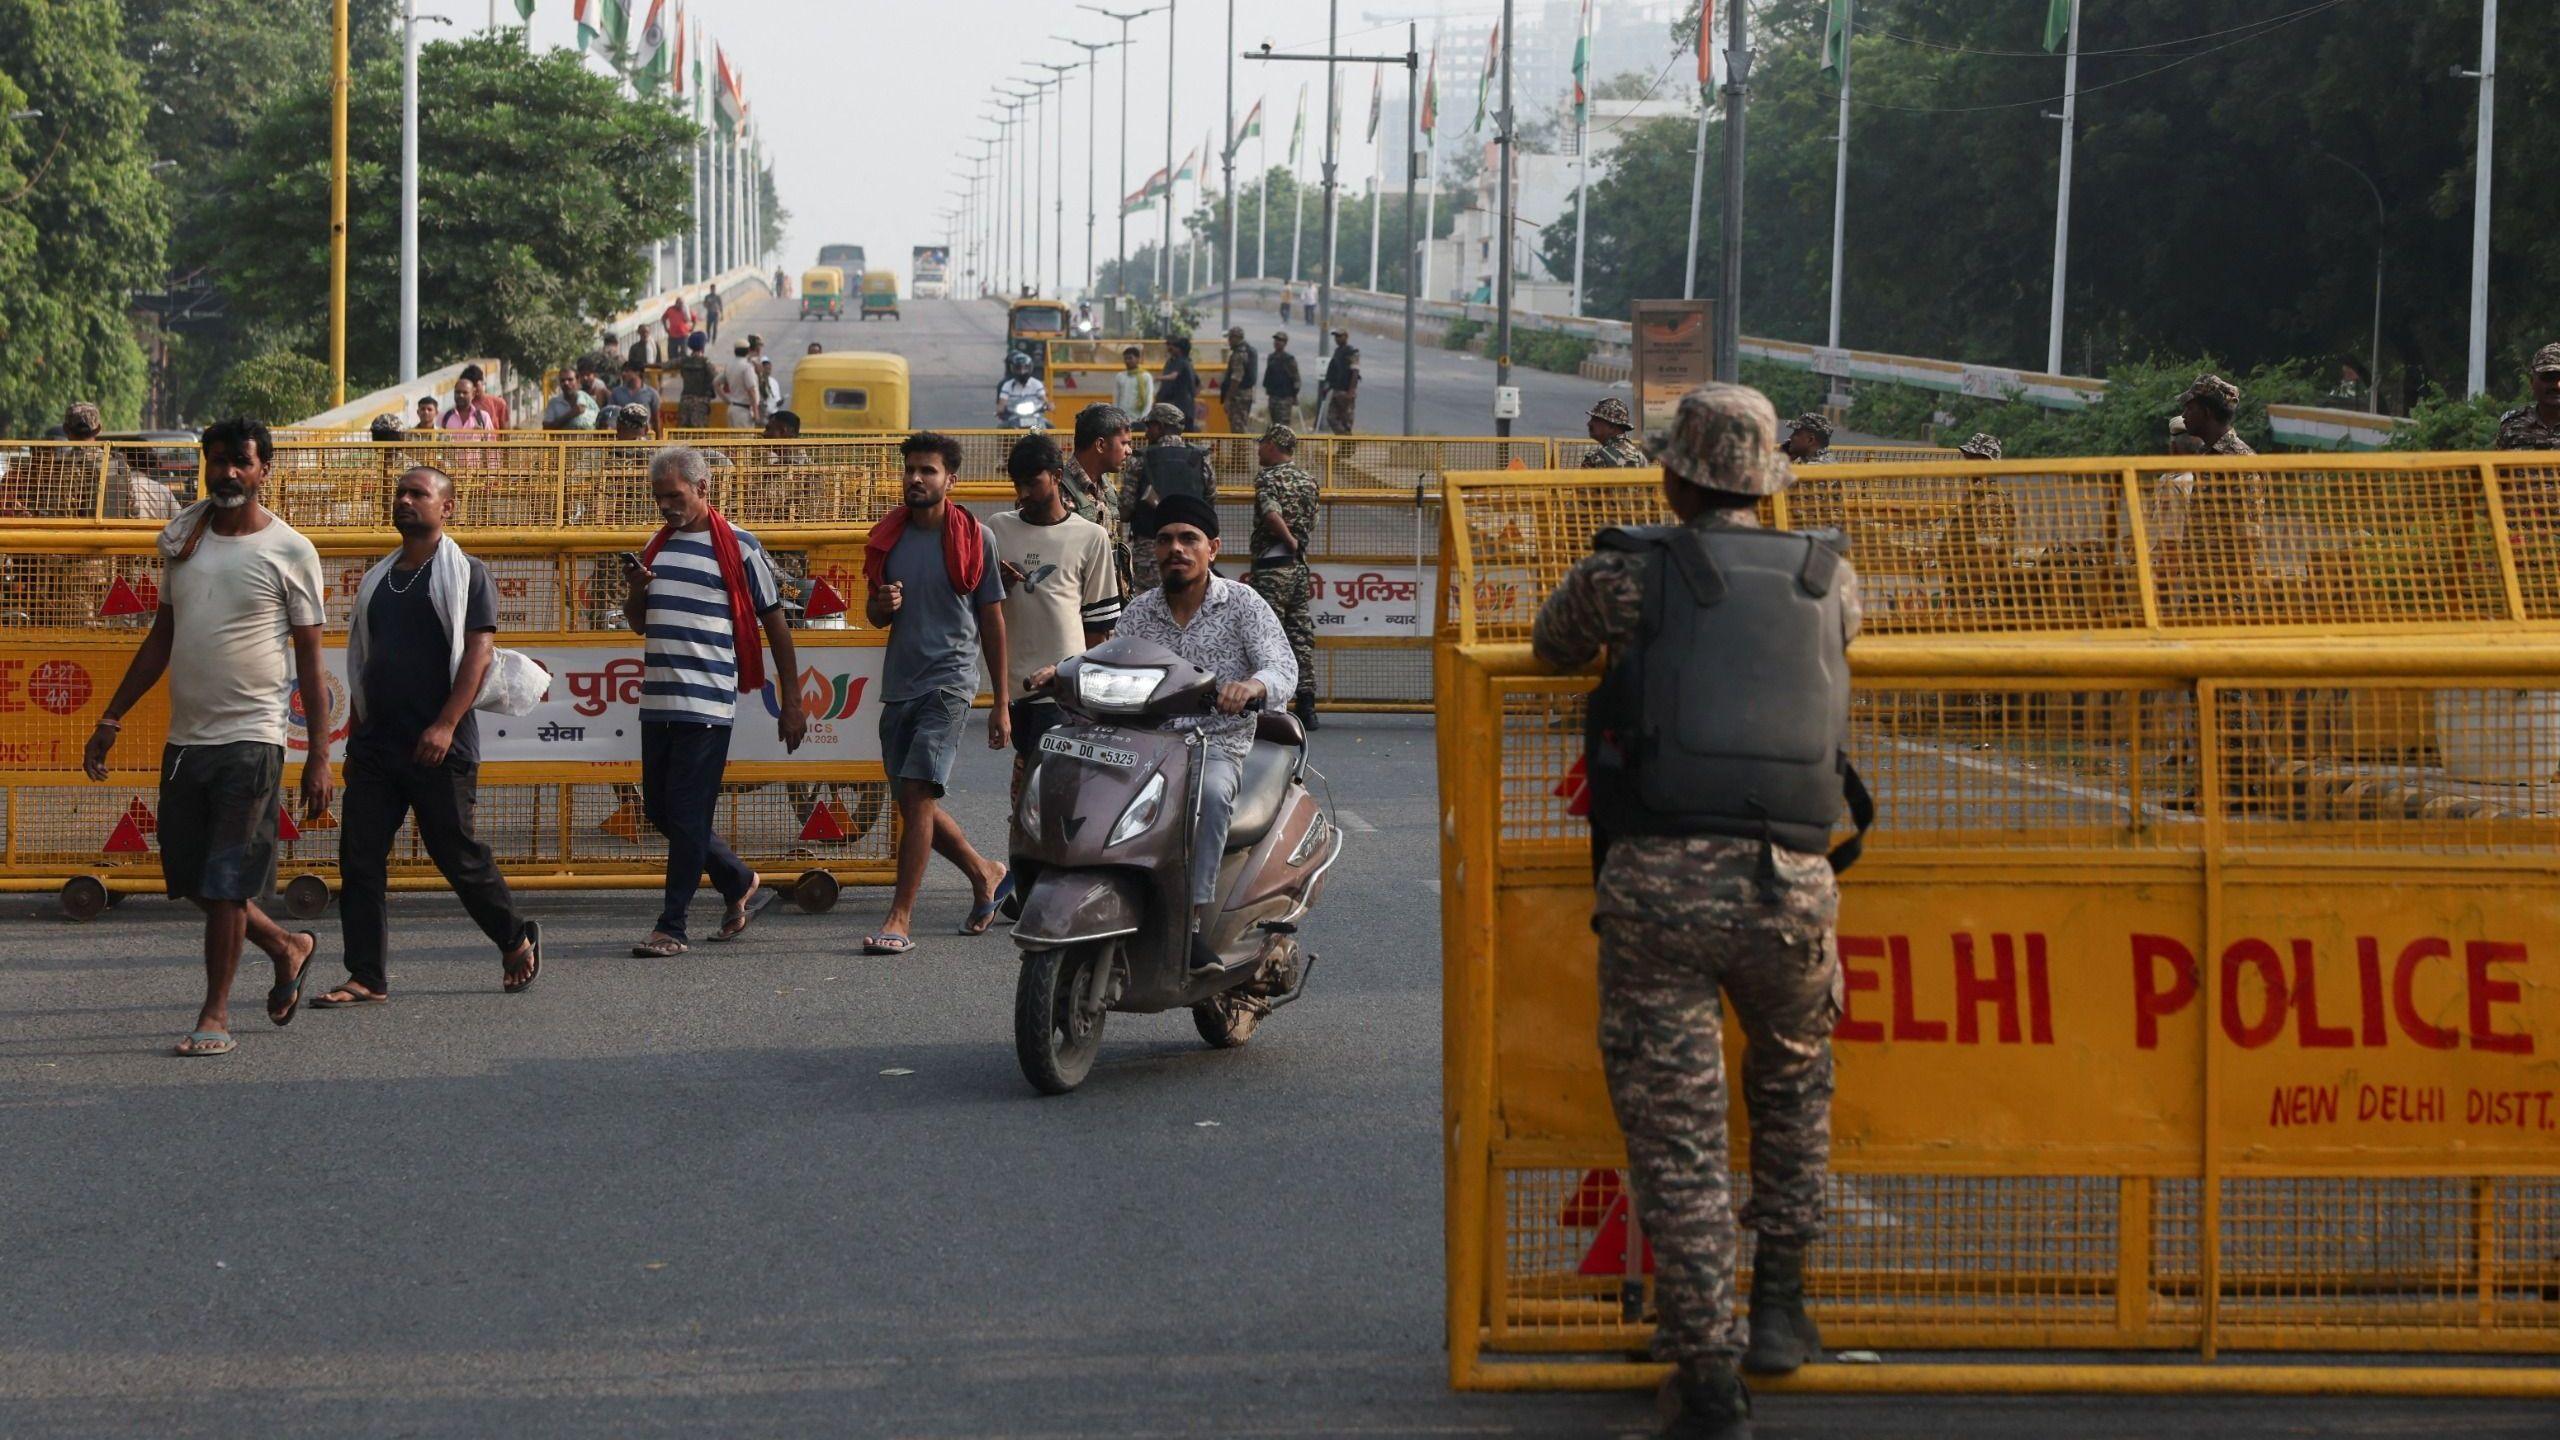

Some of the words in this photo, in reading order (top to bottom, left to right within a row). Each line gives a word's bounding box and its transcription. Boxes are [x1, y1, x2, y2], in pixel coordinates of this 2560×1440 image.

[1317, 612, 1345, 625] सेवा
[565, 658, 645, 717] पुलि
[537, 721, 586, 742] सेवा
[814, 735, 839, 744] 2026
[1042, 737, 1068, 753] DL4S
[1105, 751, 1135, 766] 5325
[1834, 932, 2054, 1045] ELHI
[2130, 933, 2535, 1055] POLICE
[2270, 1084, 2340, 1128] NEW
[2357, 1086, 2445, 1124] DELHI
